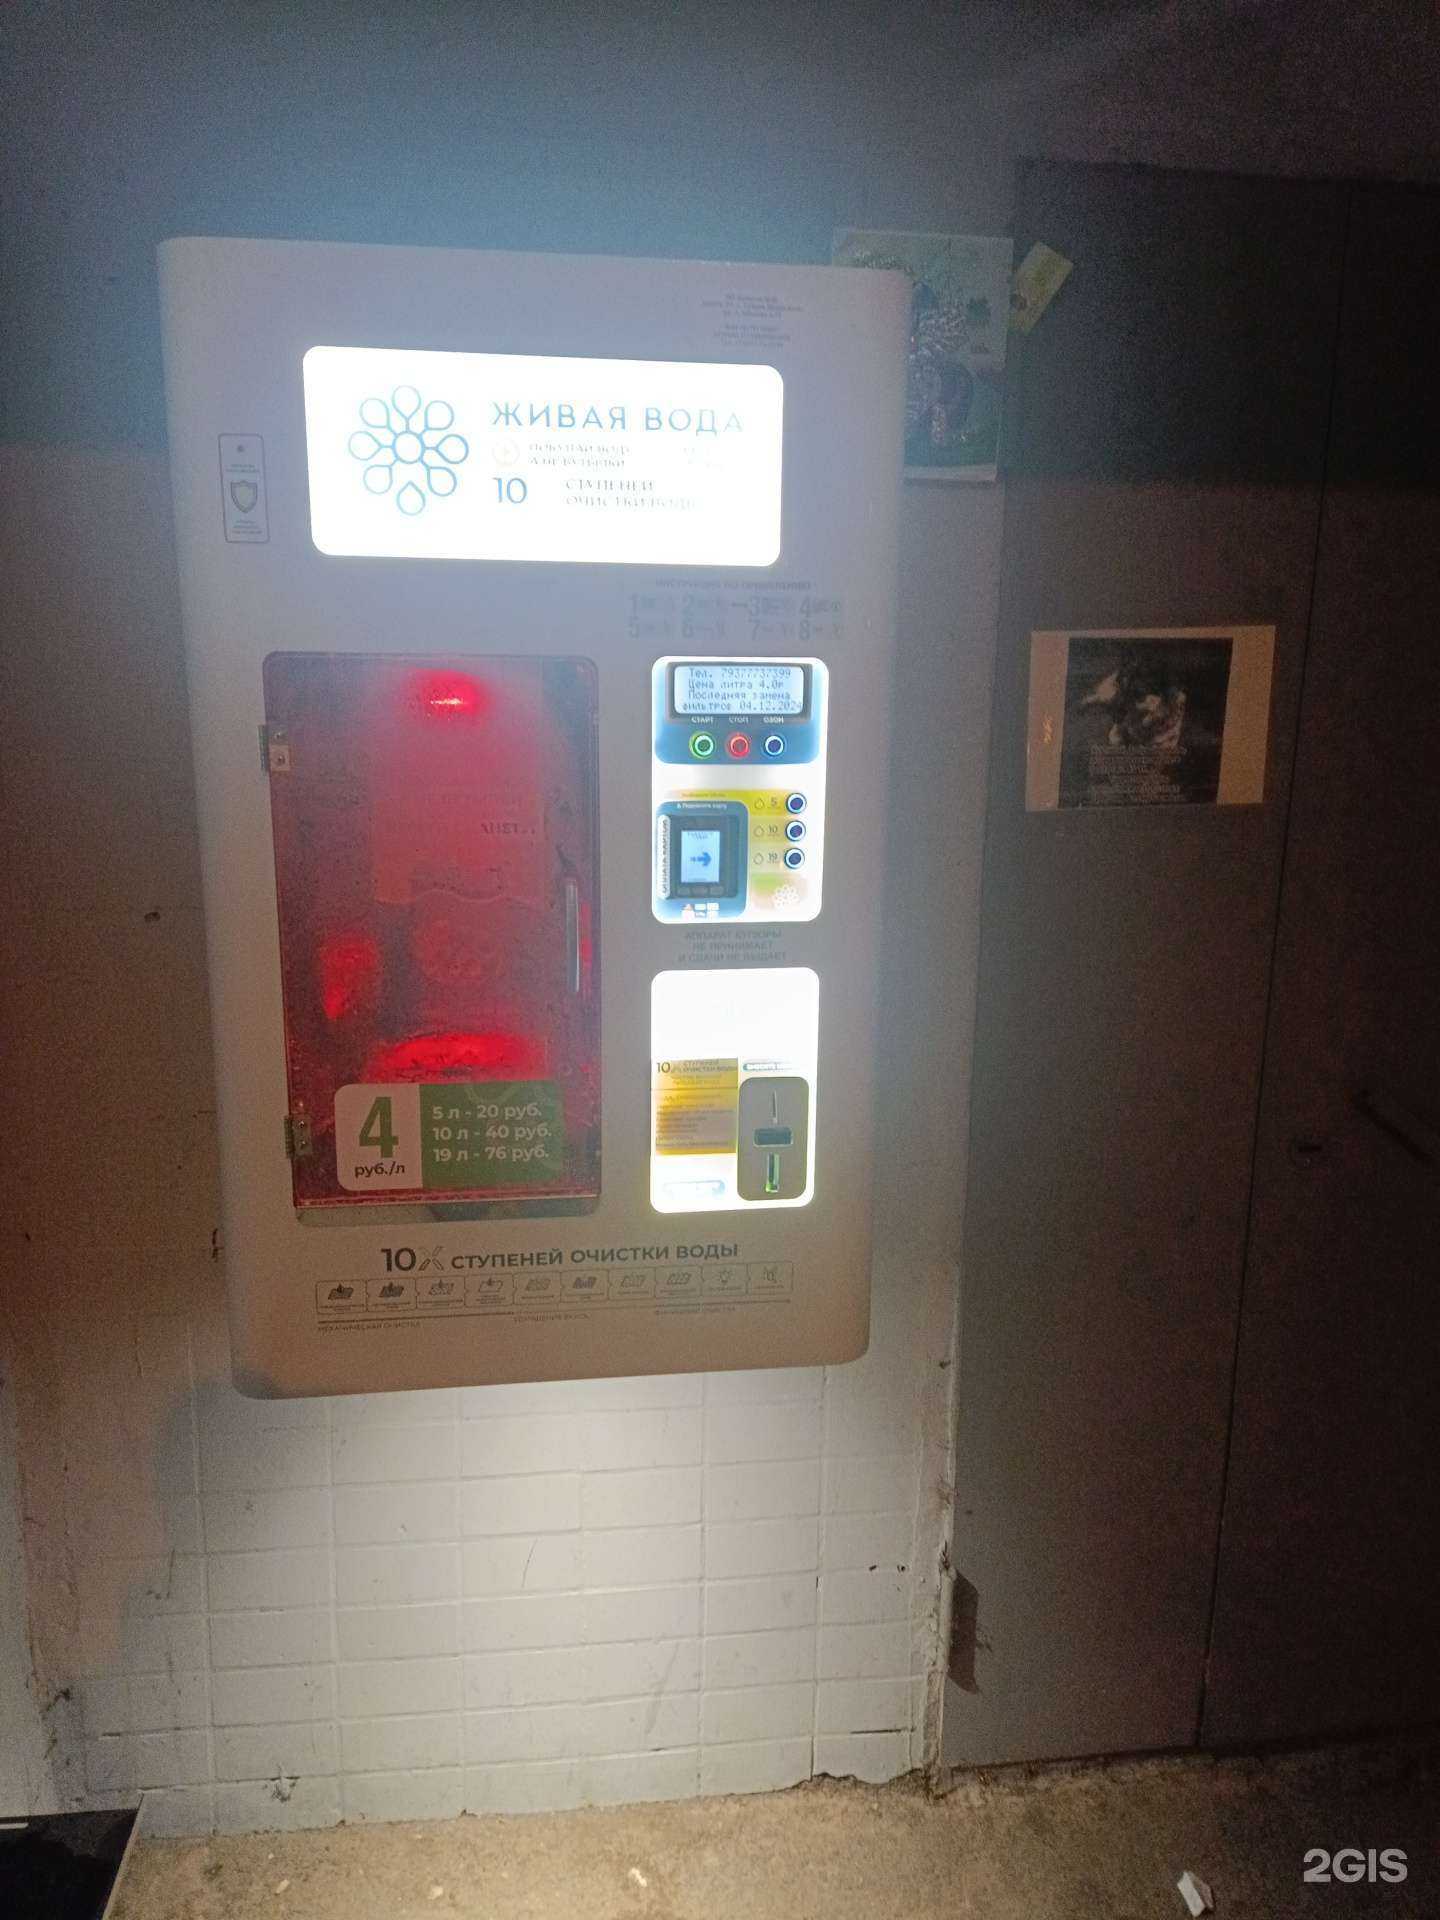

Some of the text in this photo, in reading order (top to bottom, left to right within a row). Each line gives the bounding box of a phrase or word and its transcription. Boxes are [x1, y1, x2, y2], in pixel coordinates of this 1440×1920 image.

[490, 401, 745, 437] ЖИВАЯ ВОДА
[492, 476, 529, 505] 10
[688, 679, 715, 690] Цена
[656, 1061, 671, 1075] 10
[432, 1106, 444, 1121] 5
[446, 1108, 460, 1121] л
[476, 1104, 500, 1119] 20
[504, 1102, 543, 1123] руб.
[358, 1096, 399, 1159] 4
[432, 1127, 452, 1141] 10
[455, 1129, 469, 1141] л
[485, 1125, 510, 1139] 40
[514, 1123, 553, 1142] руб.
[433, 1148, 452, 1162] 19
[455, 1150, 469, 1162] л
[485, 1146, 509, 1161] 76
[511, 1145, 549, 1163] руб.
[354, 1160, 406, 1179] руб./л
[451, 1248, 565, 1270] СТУПЕНЕЙ
[570, 1245, 670, 1264] ОЧИСТКИ
[676, 1243, 739, 1261] ВОДЫ
